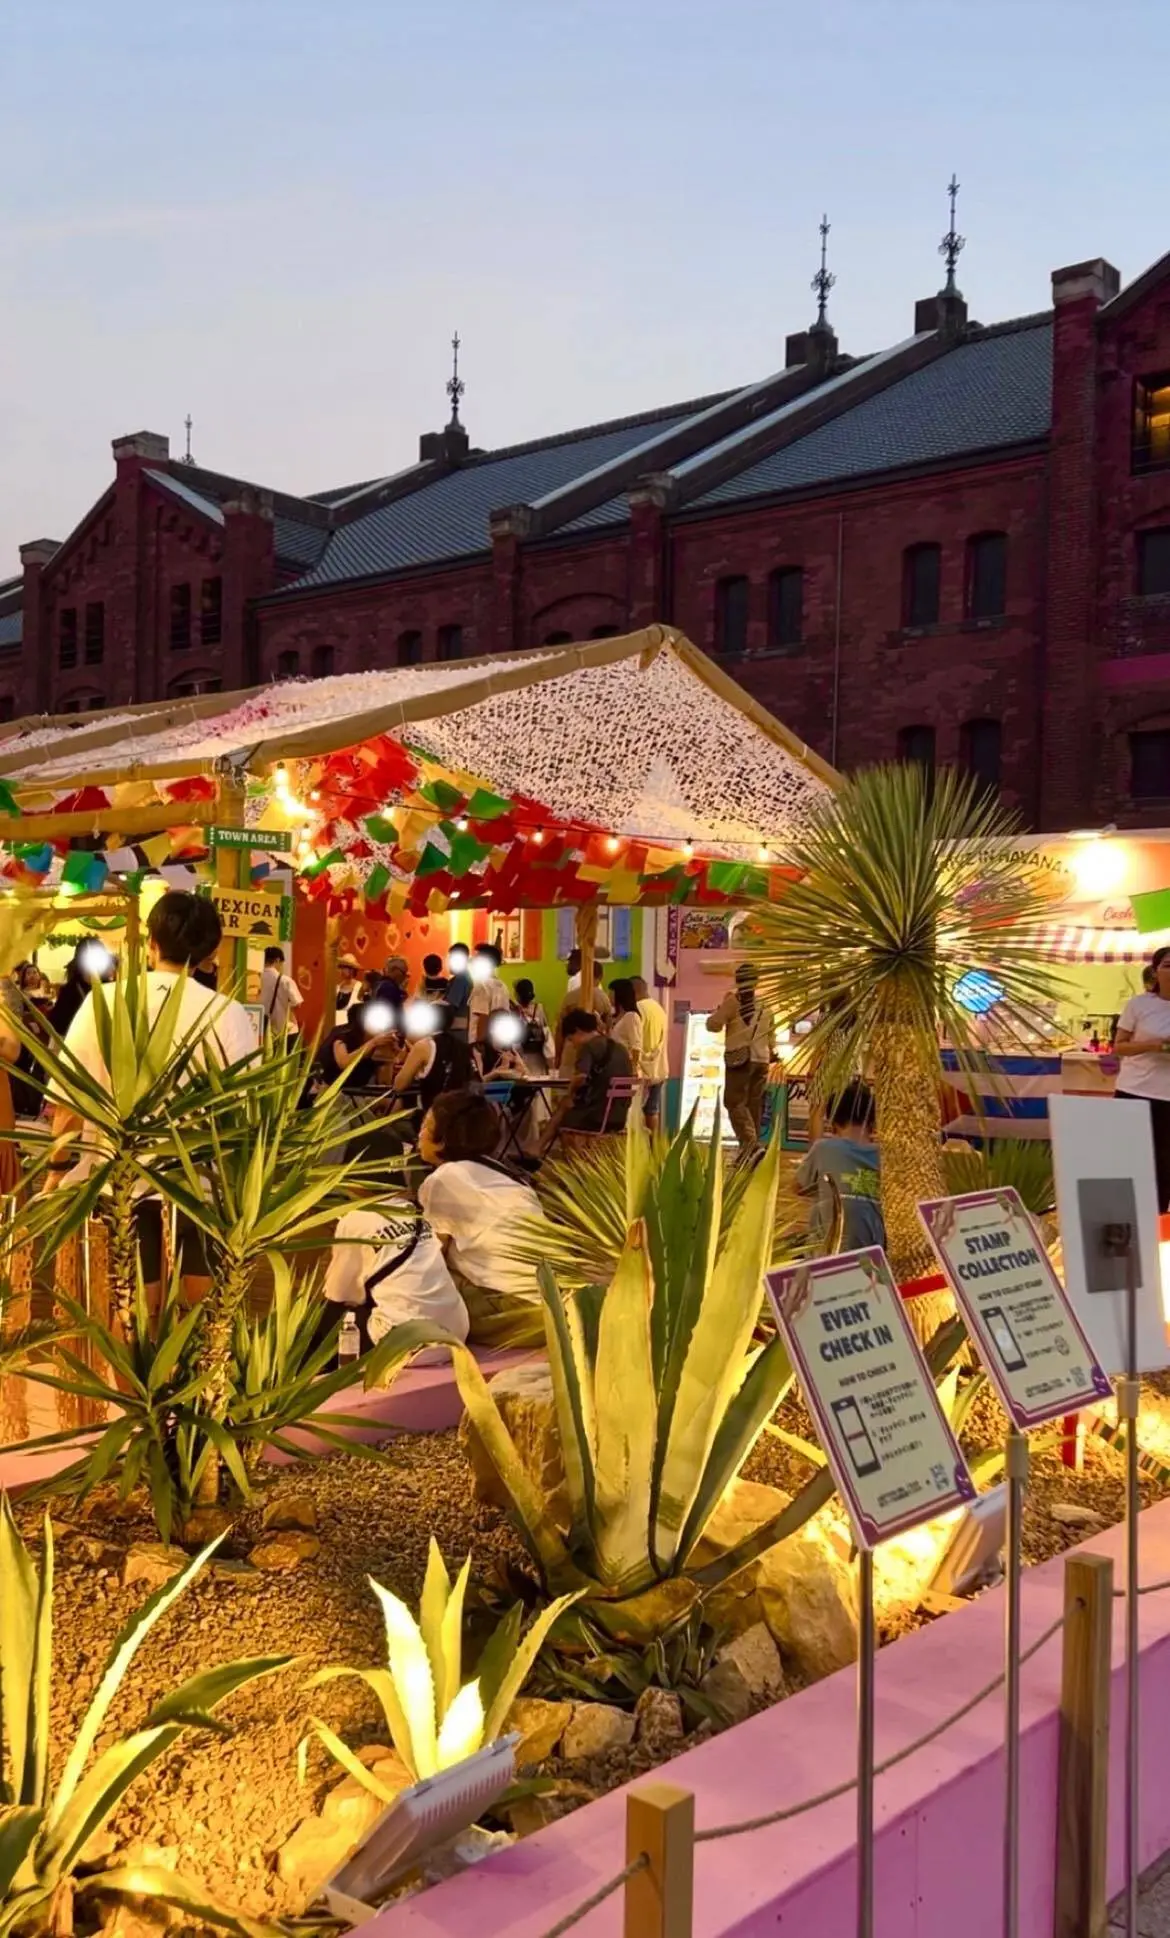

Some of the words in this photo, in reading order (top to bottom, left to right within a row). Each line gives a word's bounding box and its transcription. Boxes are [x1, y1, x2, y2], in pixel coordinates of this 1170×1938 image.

[218, 830, 250, 843] TOWN
[250, 834, 278, 845] AREA
[220, 914, 239, 928] AR
[964, 1231, 1011, 1255] STAMP
[958, 1248, 1041, 1281] COLLECTION
[820, 1302, 871, 1332] EVENT
[819, 1331, 874, 1363] CHECK
[875, 1324, 894, 1346] IN
